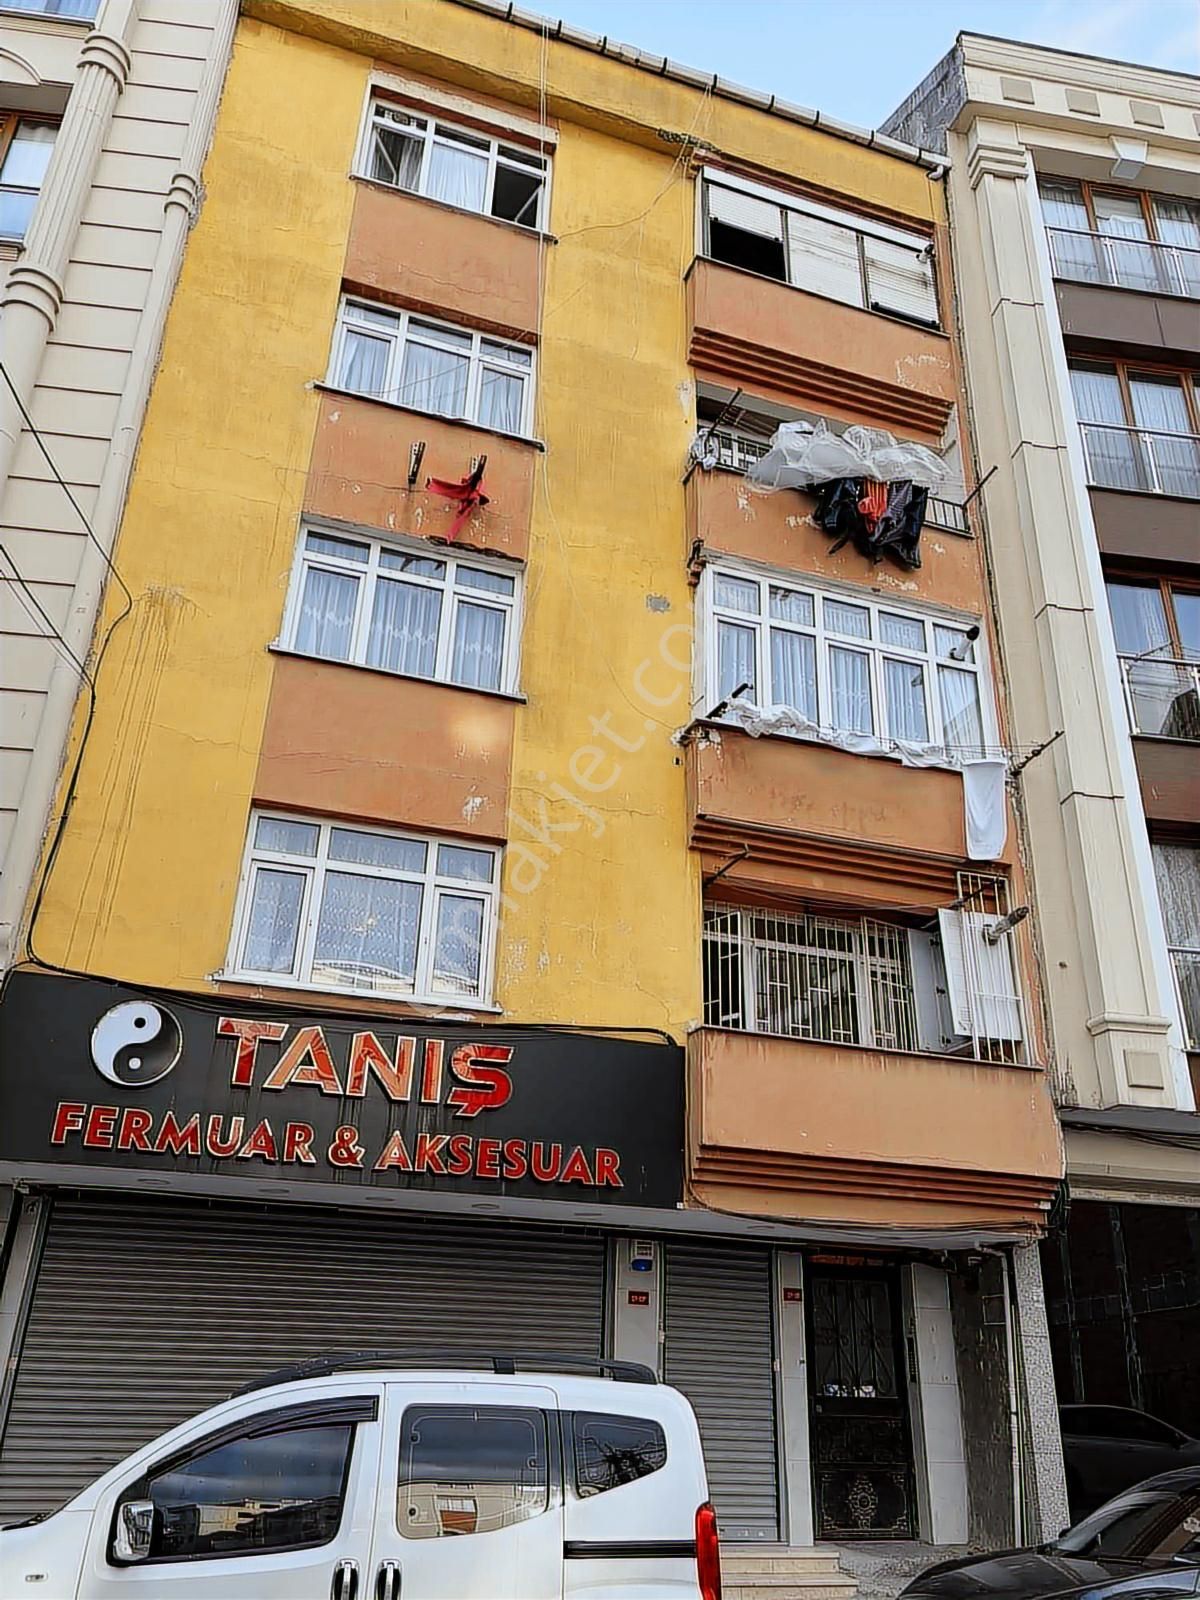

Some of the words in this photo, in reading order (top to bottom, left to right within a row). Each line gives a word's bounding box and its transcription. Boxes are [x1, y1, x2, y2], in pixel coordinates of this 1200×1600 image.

[216, 1016, 515, 1118] TANIŞ
[51, 1102, 317, 1164] FERMUAR
[328, 1125, 365, 1169] &
[374, 1130, 625, 1188] AKSESUAR
